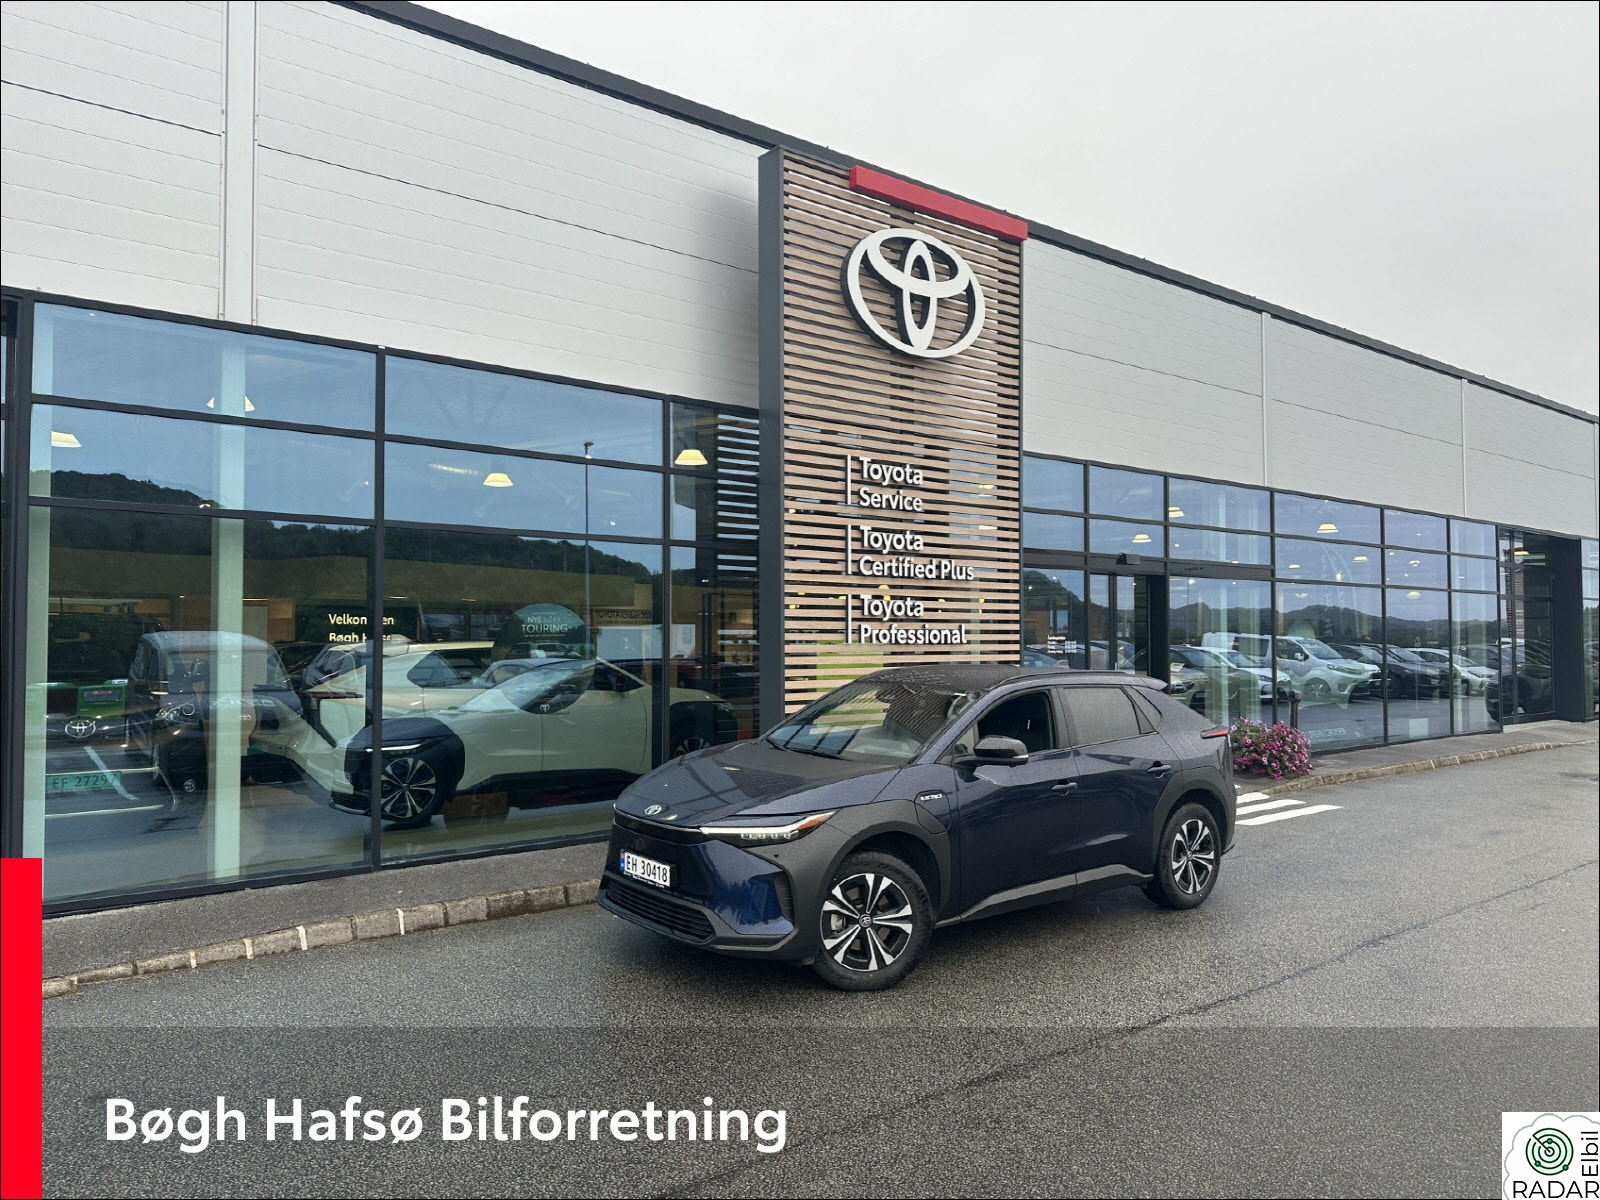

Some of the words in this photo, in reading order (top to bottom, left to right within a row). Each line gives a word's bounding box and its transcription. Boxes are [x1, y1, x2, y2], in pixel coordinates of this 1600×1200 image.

[859, 456, 923, 485] Toyota
[859, 487, 923, 511] Service
[859, 525, 924, 554] Toyota
[859, 555, 936, 579] Certified
[940, 559, 975, 580] Plus
[328, 613, 394, 625] Velkomen
[859, 594, 924, 621] Toyota
[521, 623, 568, 633] TOURING
[859, 624, 968, 645] Professional
[52, 776, 68, 789] EF
[626, 855, 638, 873] EH
[641, 860, 668, 883] 30418
